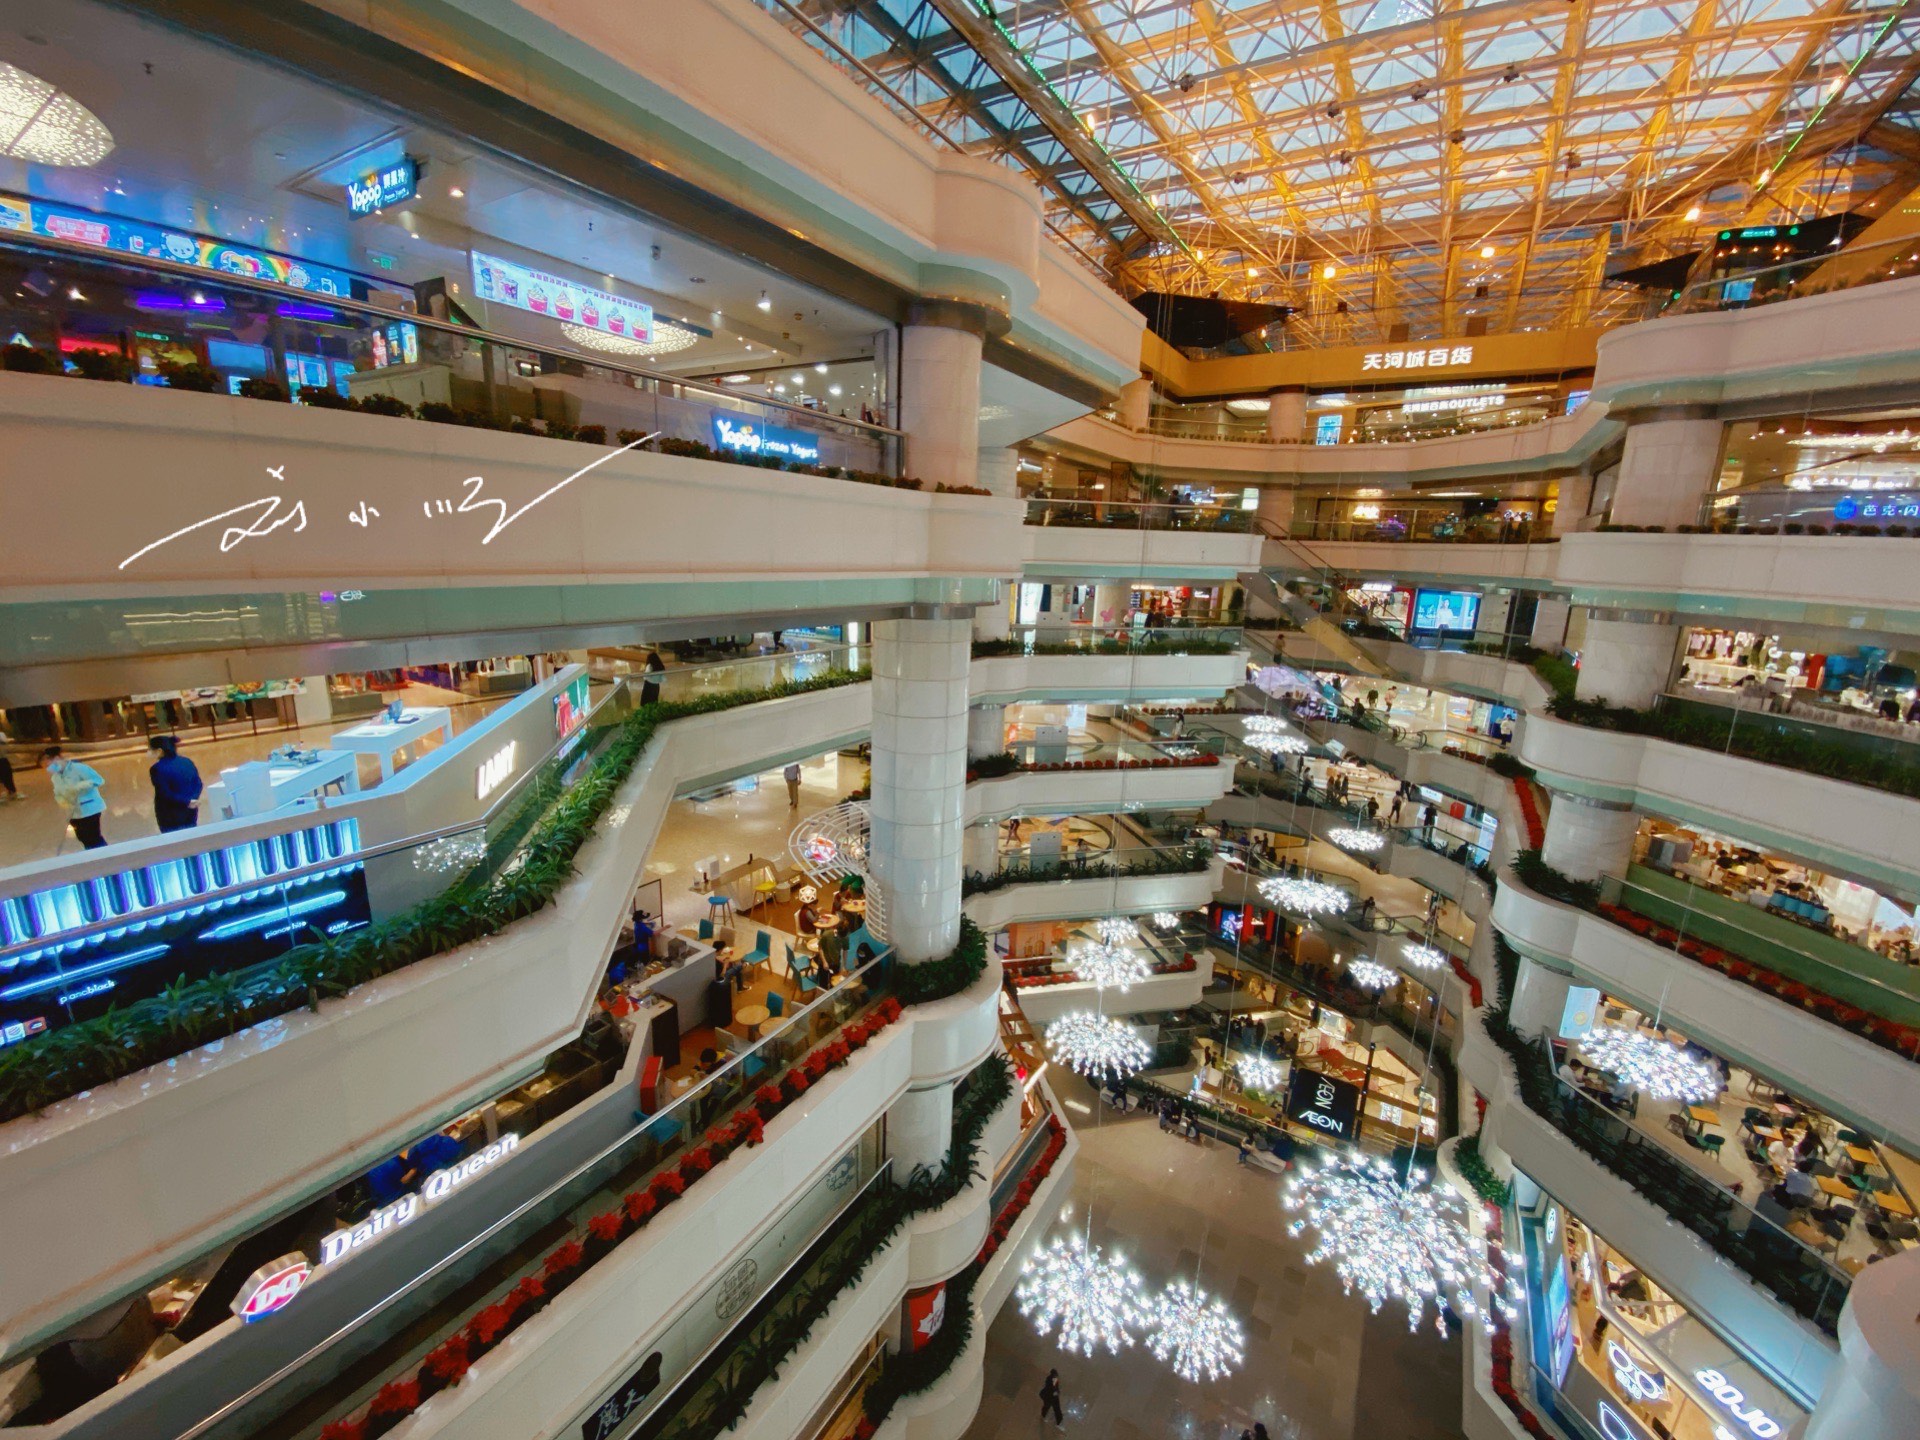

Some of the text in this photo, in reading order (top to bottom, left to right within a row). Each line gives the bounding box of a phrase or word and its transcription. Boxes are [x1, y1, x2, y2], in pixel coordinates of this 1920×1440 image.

[349, 182, 381, 211] Yopop
[1362, 346, 1474, 371] 天河城百货
[716, 419, 761, 452] Yopop
[59, 979, 116, 1005] panoblack
[323, 1132, 519, 1265] Dairy Queen
[254, 1273, 302, 1312] DQ
